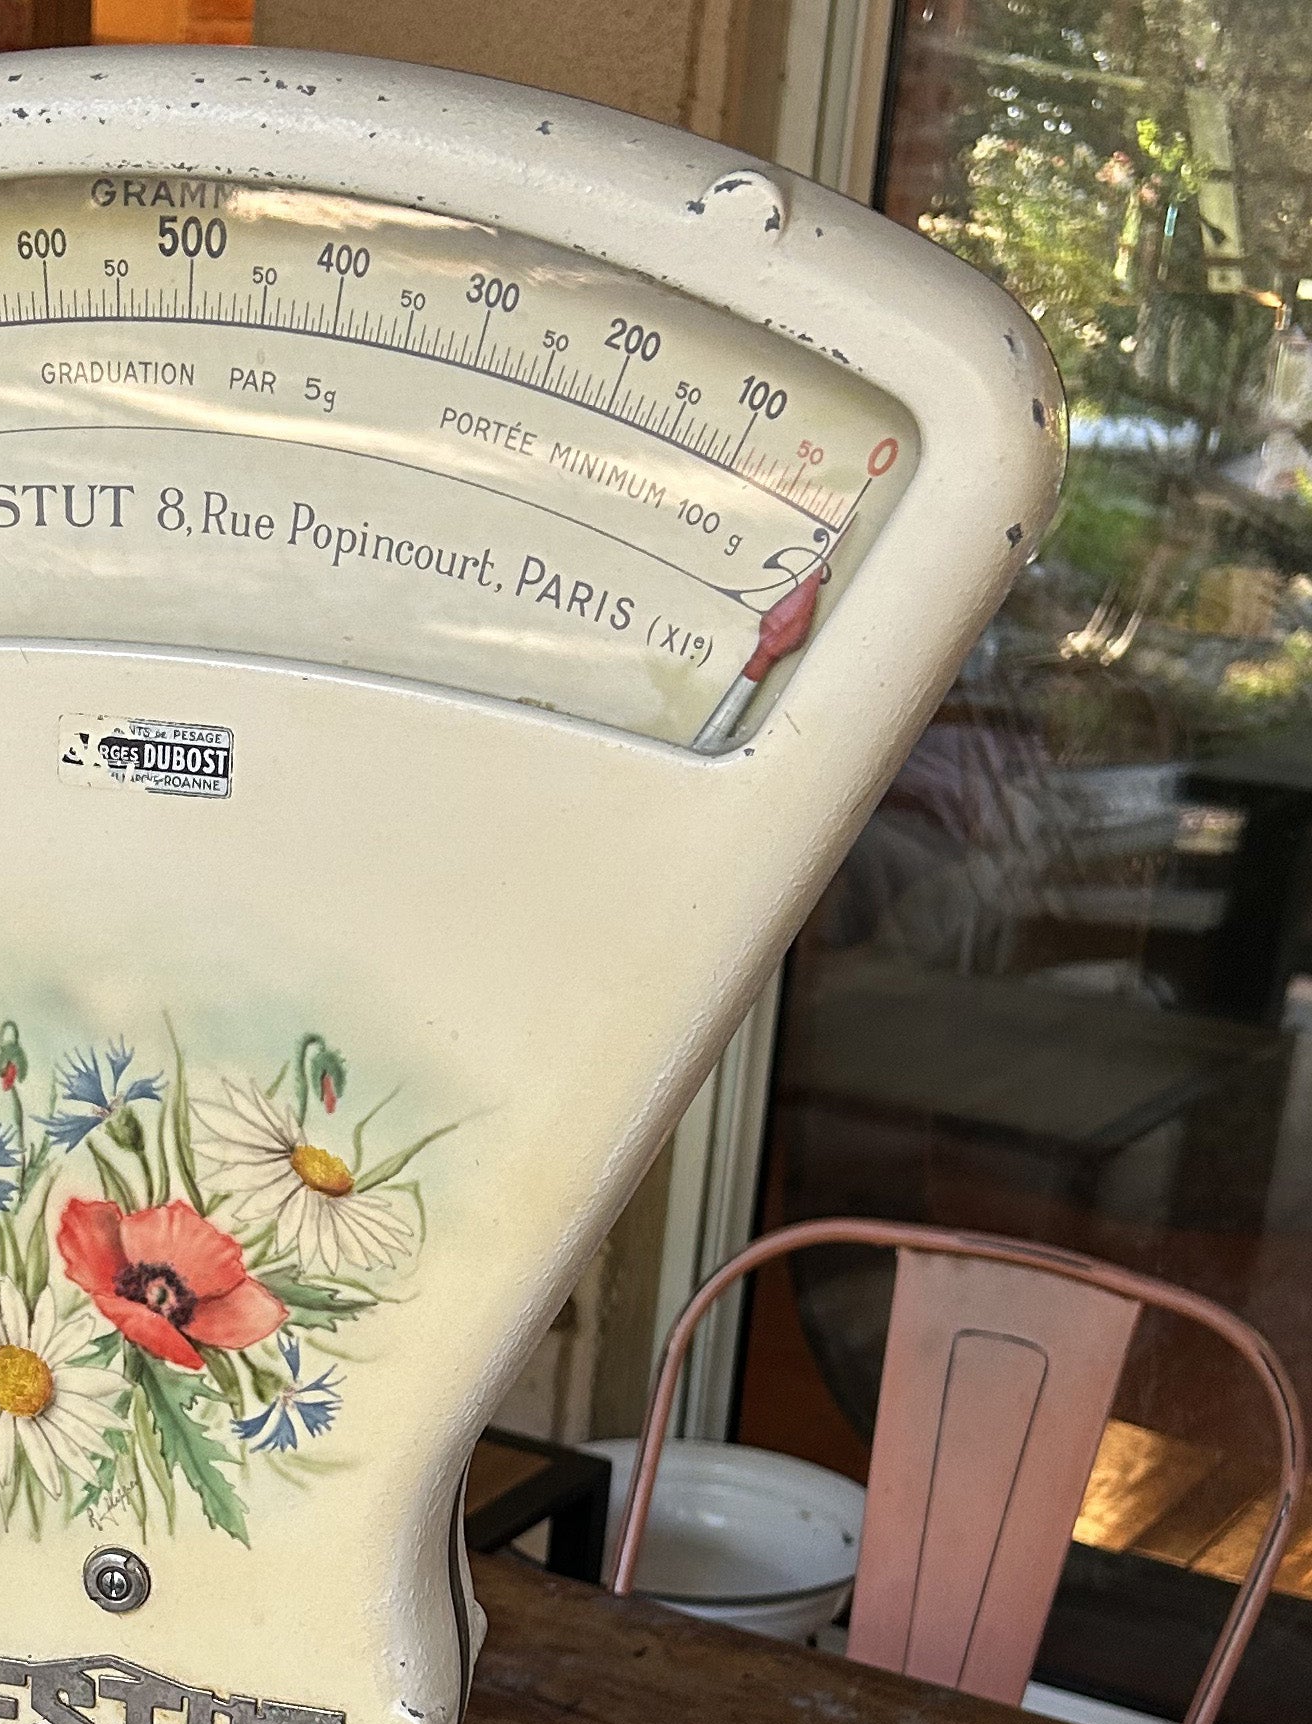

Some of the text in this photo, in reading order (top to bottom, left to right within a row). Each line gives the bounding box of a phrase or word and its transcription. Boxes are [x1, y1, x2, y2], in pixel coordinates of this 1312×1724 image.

[91, 178, 234, 208] GRAMM
[17, 228, 67, 259] 600
[103, 260, 128, 277] 50
[157, 215, 227, 259] 500
[252, 267, 277, 285] 50
[317, 243, 370, 278] 400
[401, 291, 426, 311] 50
[466, 273, 520, 312] 300
[543, 329, 569, 352] 50
[605, 318, 661, 362] 200
[675, 382, 702, 405] 50
[738, 375, 788, 420] 100
[796, 440, 824, 465] 50
[41, 361, 195, 387] GRADUATION
[229, 368, 277, 394] PAR
[440, 408, 743, 557] PORTÉE MINIMUM 100 g
[288, 502, 503, 594] Popincourt,
[515, 556, 636, 631] PARIS
[173, 729, 223, 745] PESAGE
[99, 743, 228, 775] RGES DUBOST
